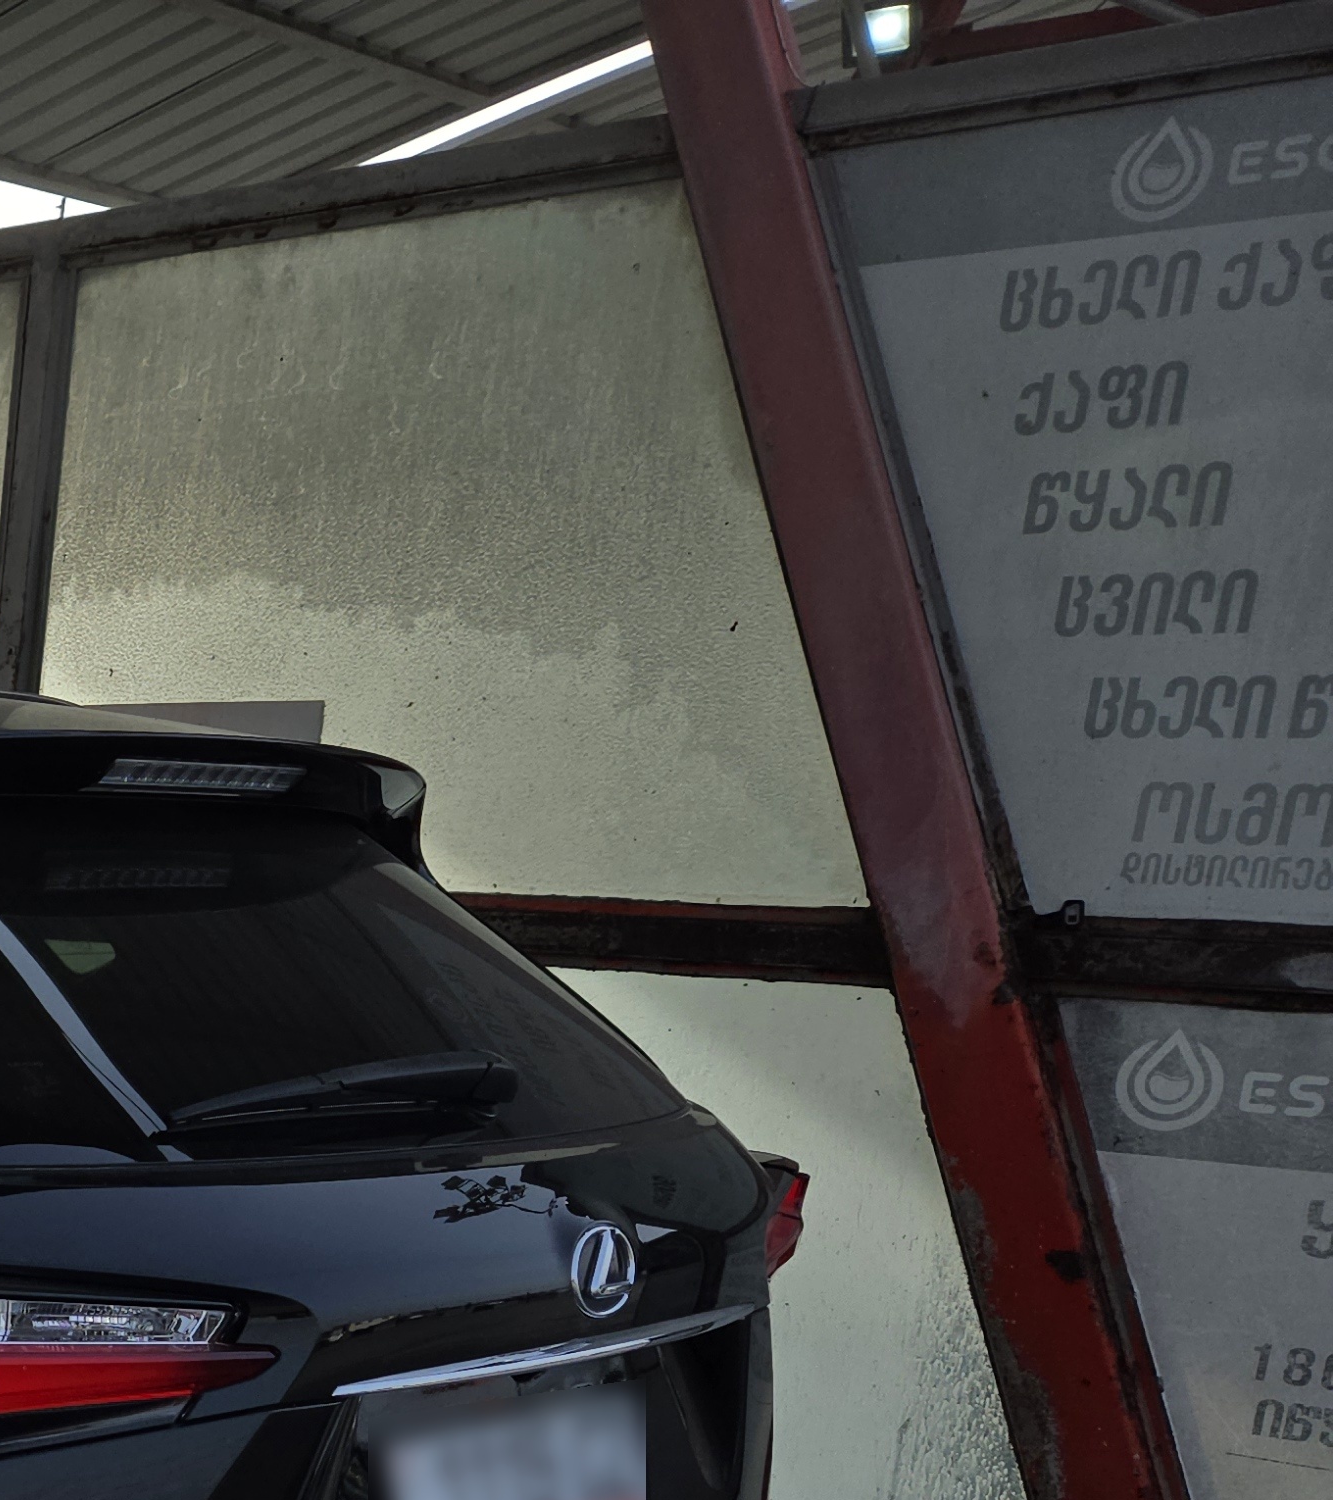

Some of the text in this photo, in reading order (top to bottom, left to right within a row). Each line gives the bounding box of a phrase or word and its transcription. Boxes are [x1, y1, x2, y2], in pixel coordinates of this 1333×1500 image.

[999, 249, 1202, 332] ცხელი
[1014, 361, 1189, 436] ქაფი
[1023, 461, 1232, 535] წყალი
[1054, 568, 1259, 637] ცვილი
[1084, 675, 1277, 740] ცხელი
